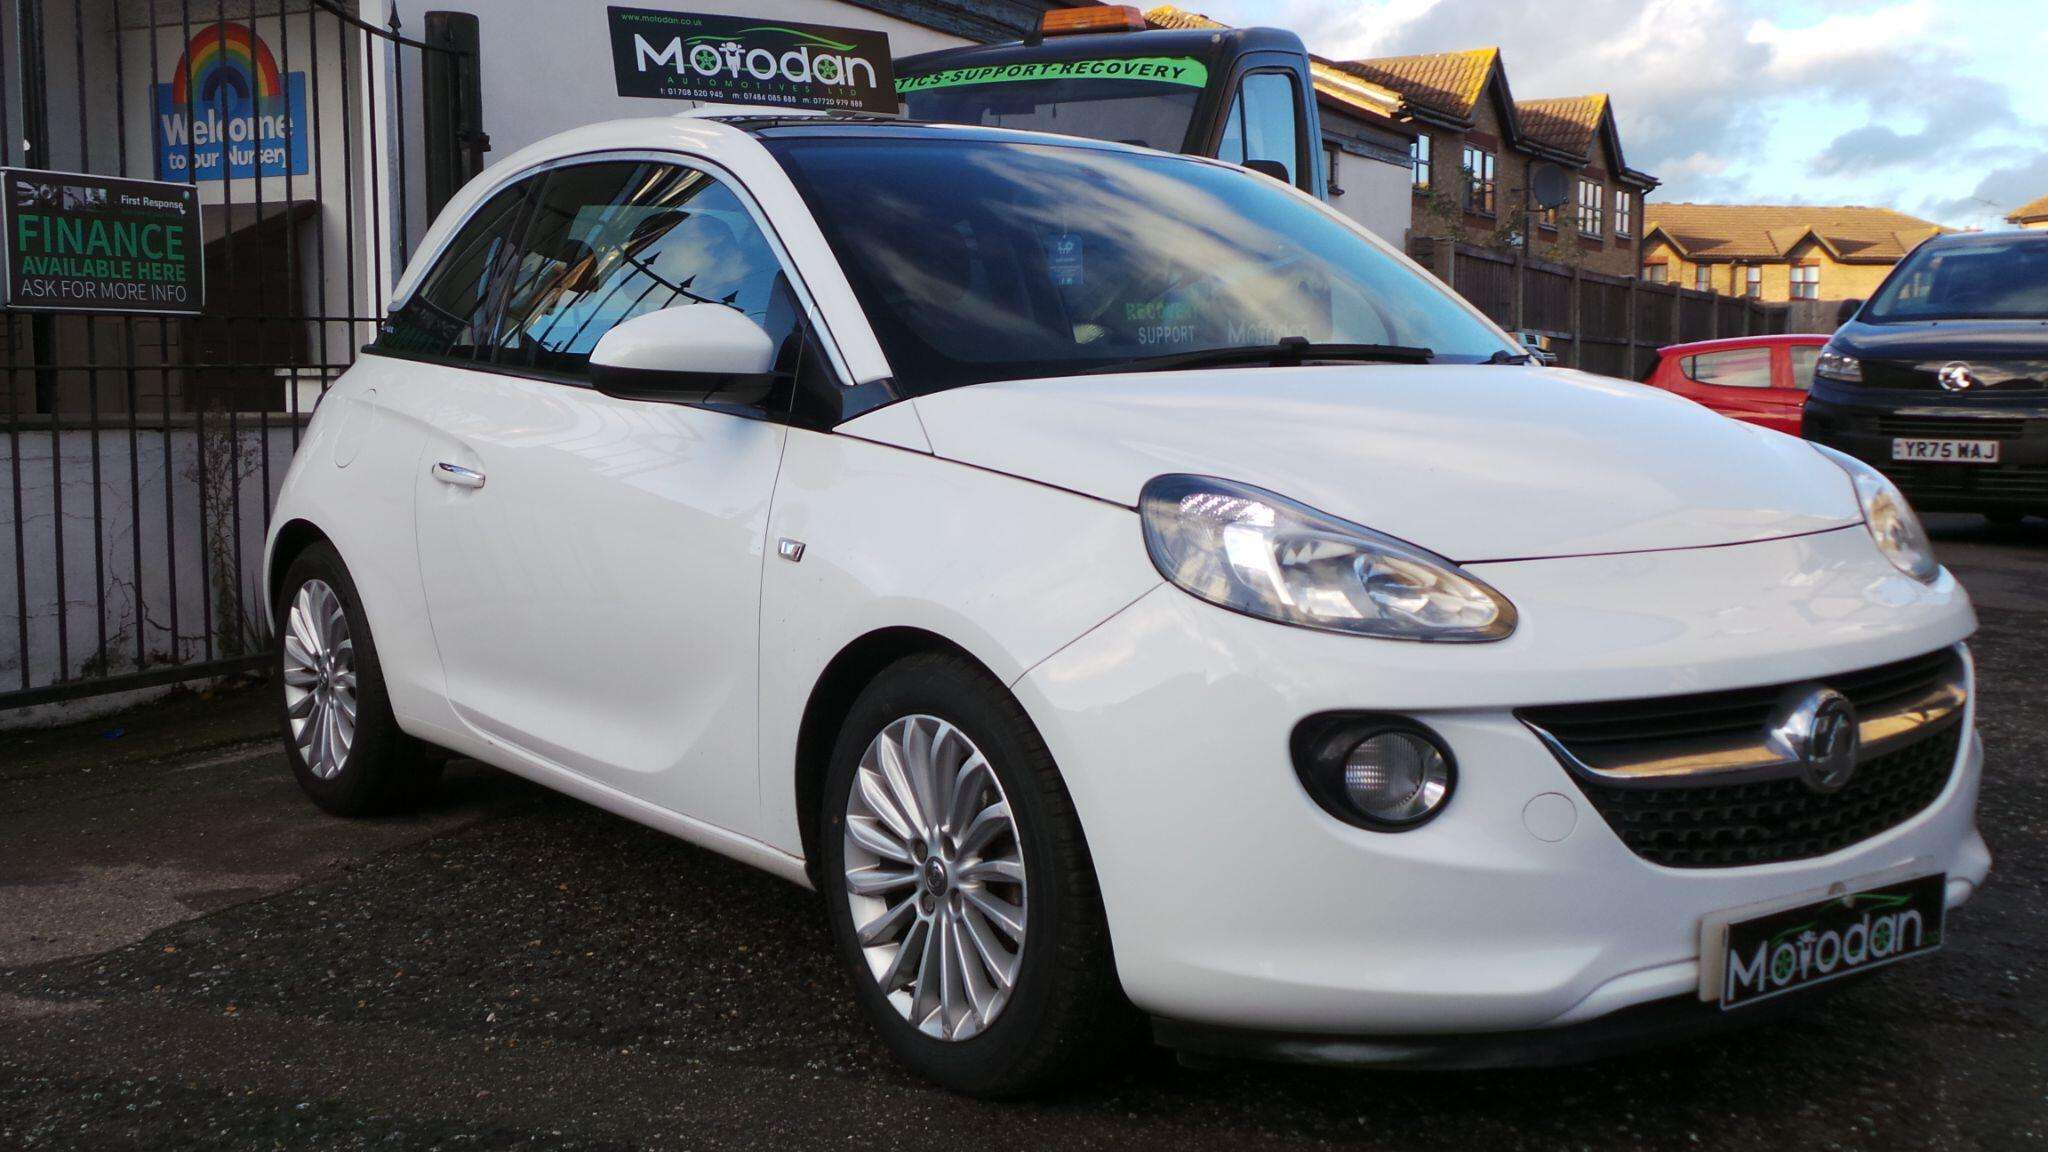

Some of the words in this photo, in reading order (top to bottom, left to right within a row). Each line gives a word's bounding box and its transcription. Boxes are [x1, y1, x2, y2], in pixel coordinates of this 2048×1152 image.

[168, 152, 187, 170] to
[121, 194, 141, 206] First
[143, 196, 184, 210] Response
[17, 214, 185, 261] FINANCE
[22, 255, 132, 279] AVAILABLE
[138, 262, 186, 282] HERE
[21, 279, 58, 297] ASK
[61, 280, 97, 299] FOR
[100, 281, 147, 301] MORE
[152, 284, 187, 303] INFO
[1137, 325, 1195, 345] SUPPORT
[1905, 441, 1952, 458] YR75
[1728, 909, 1922, 1001] Motodan
